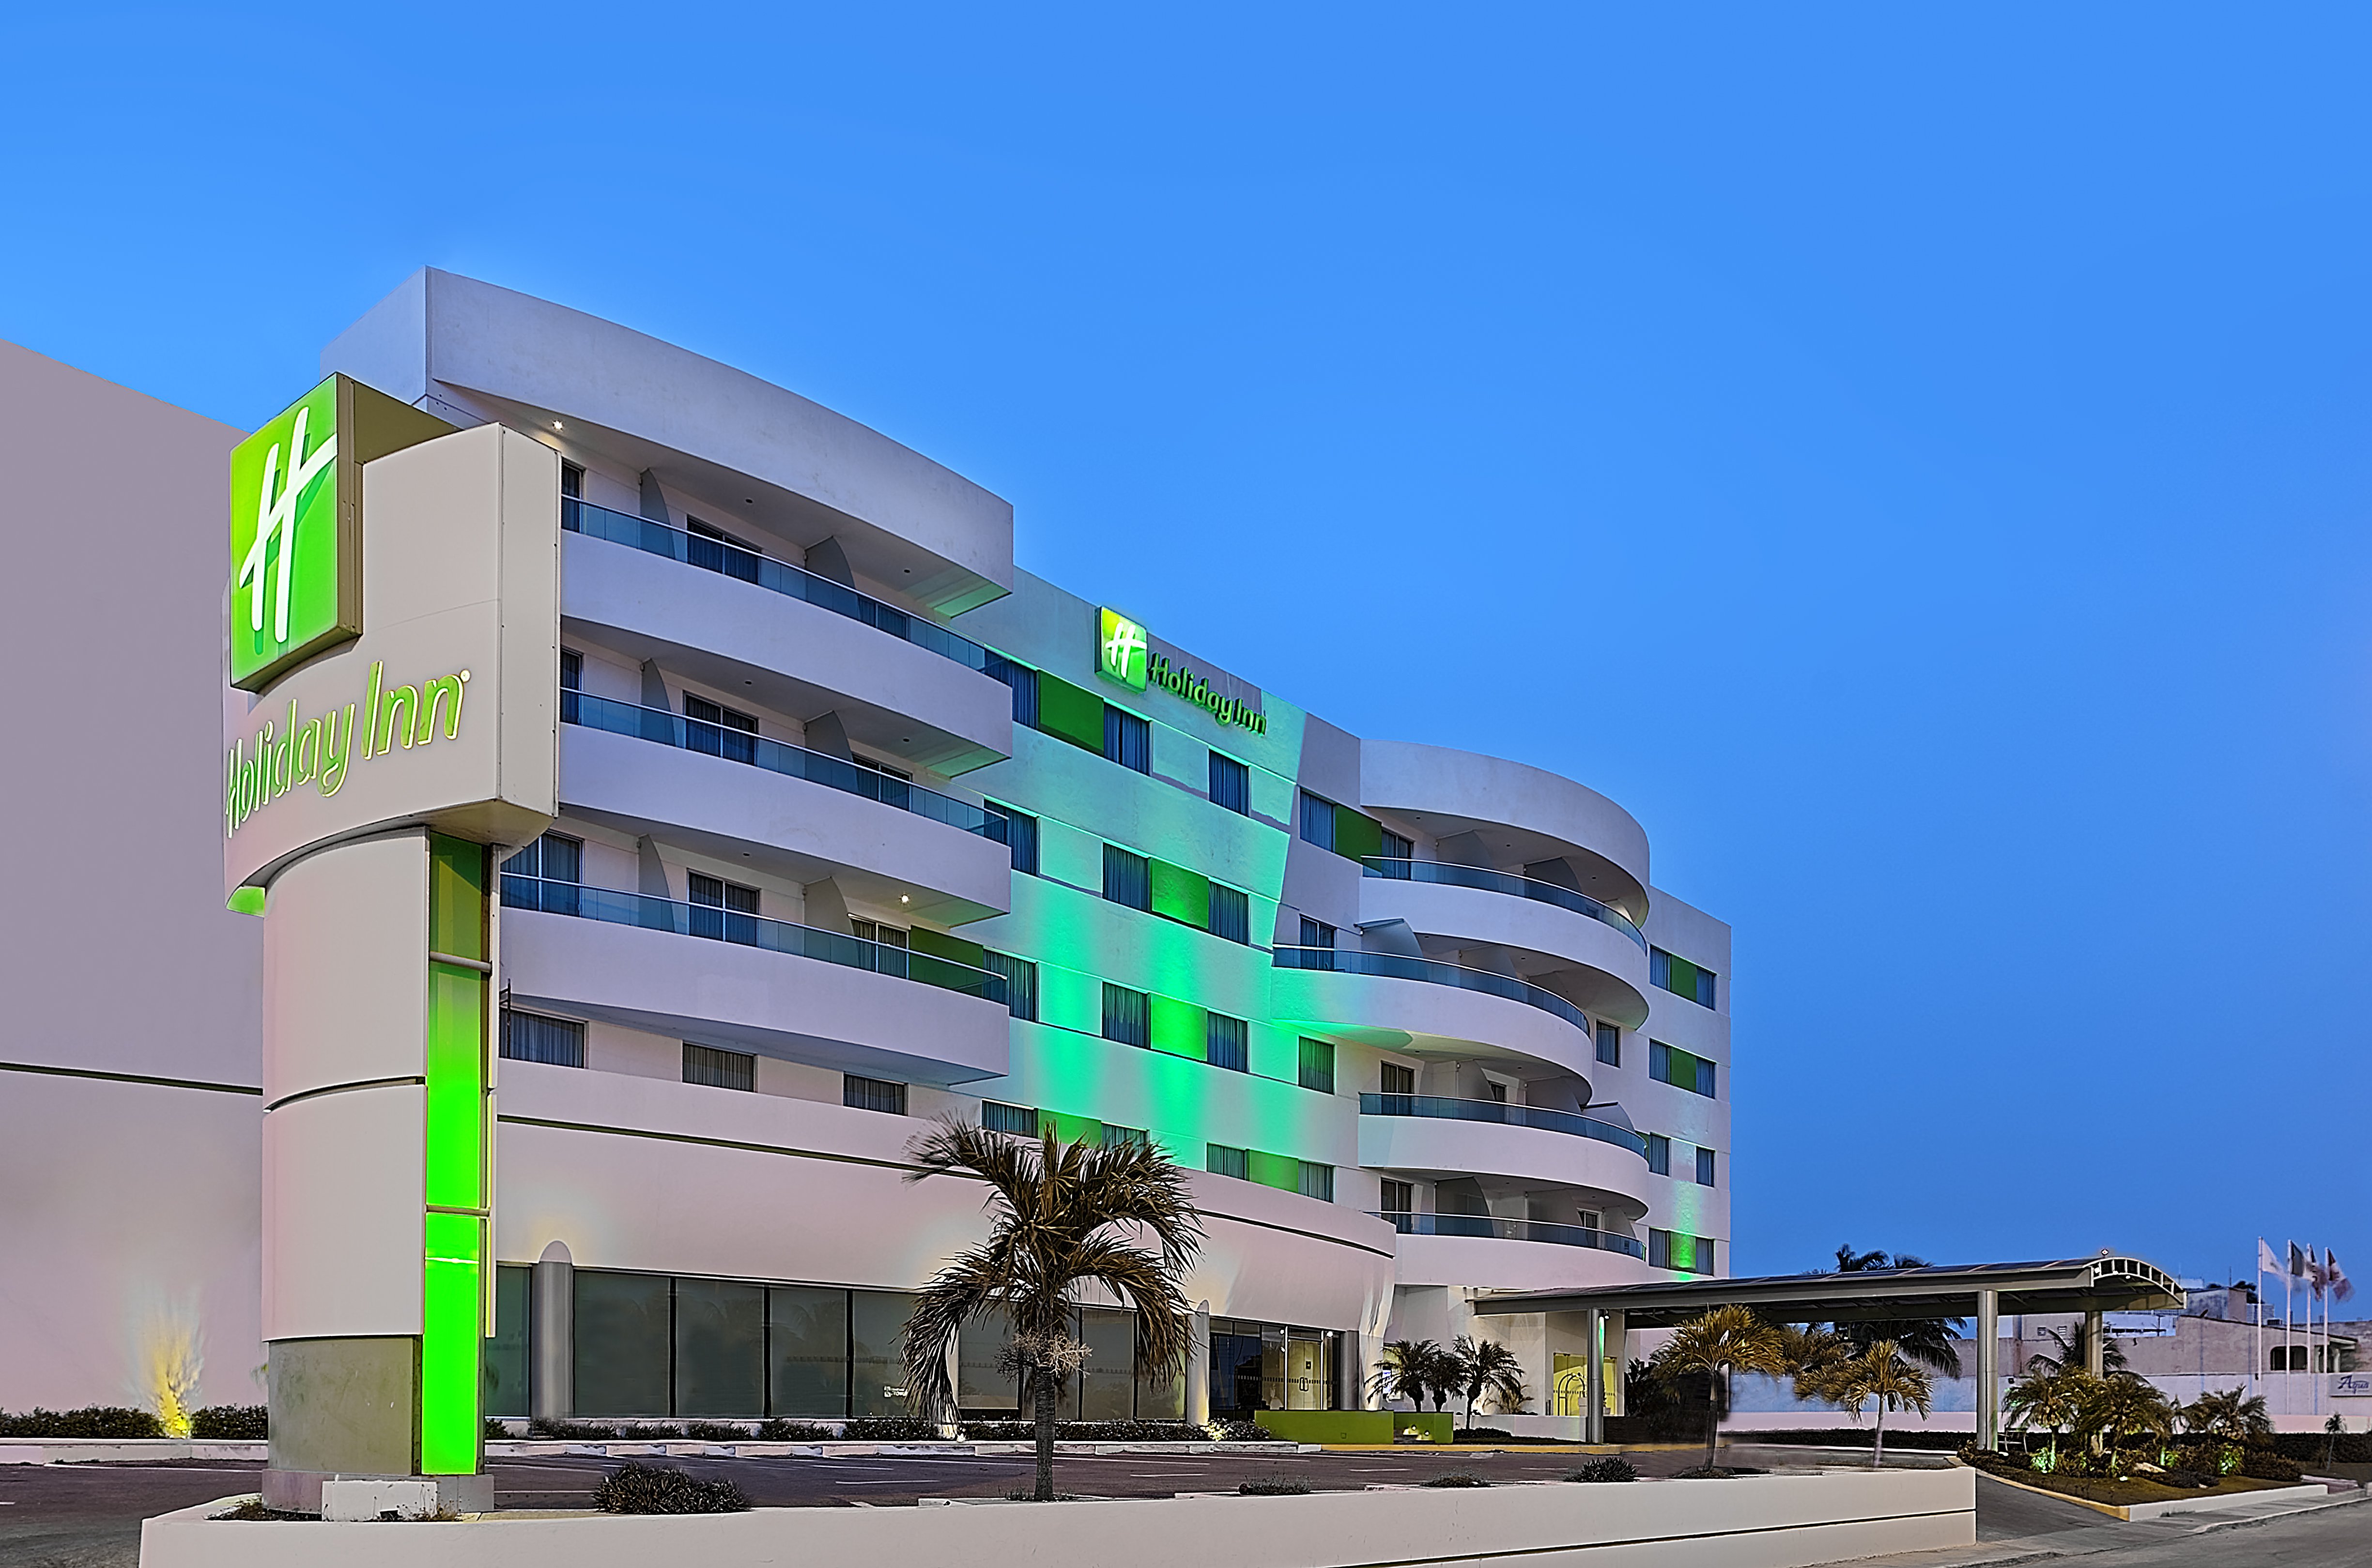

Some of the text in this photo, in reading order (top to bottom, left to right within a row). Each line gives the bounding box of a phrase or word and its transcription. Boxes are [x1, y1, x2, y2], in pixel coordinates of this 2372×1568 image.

[1148, 653, 1267, 736] Holiday Inn
[226, 698, 355, 839] Holiday
[2337, 1375, 2369, 1394] Aqua
